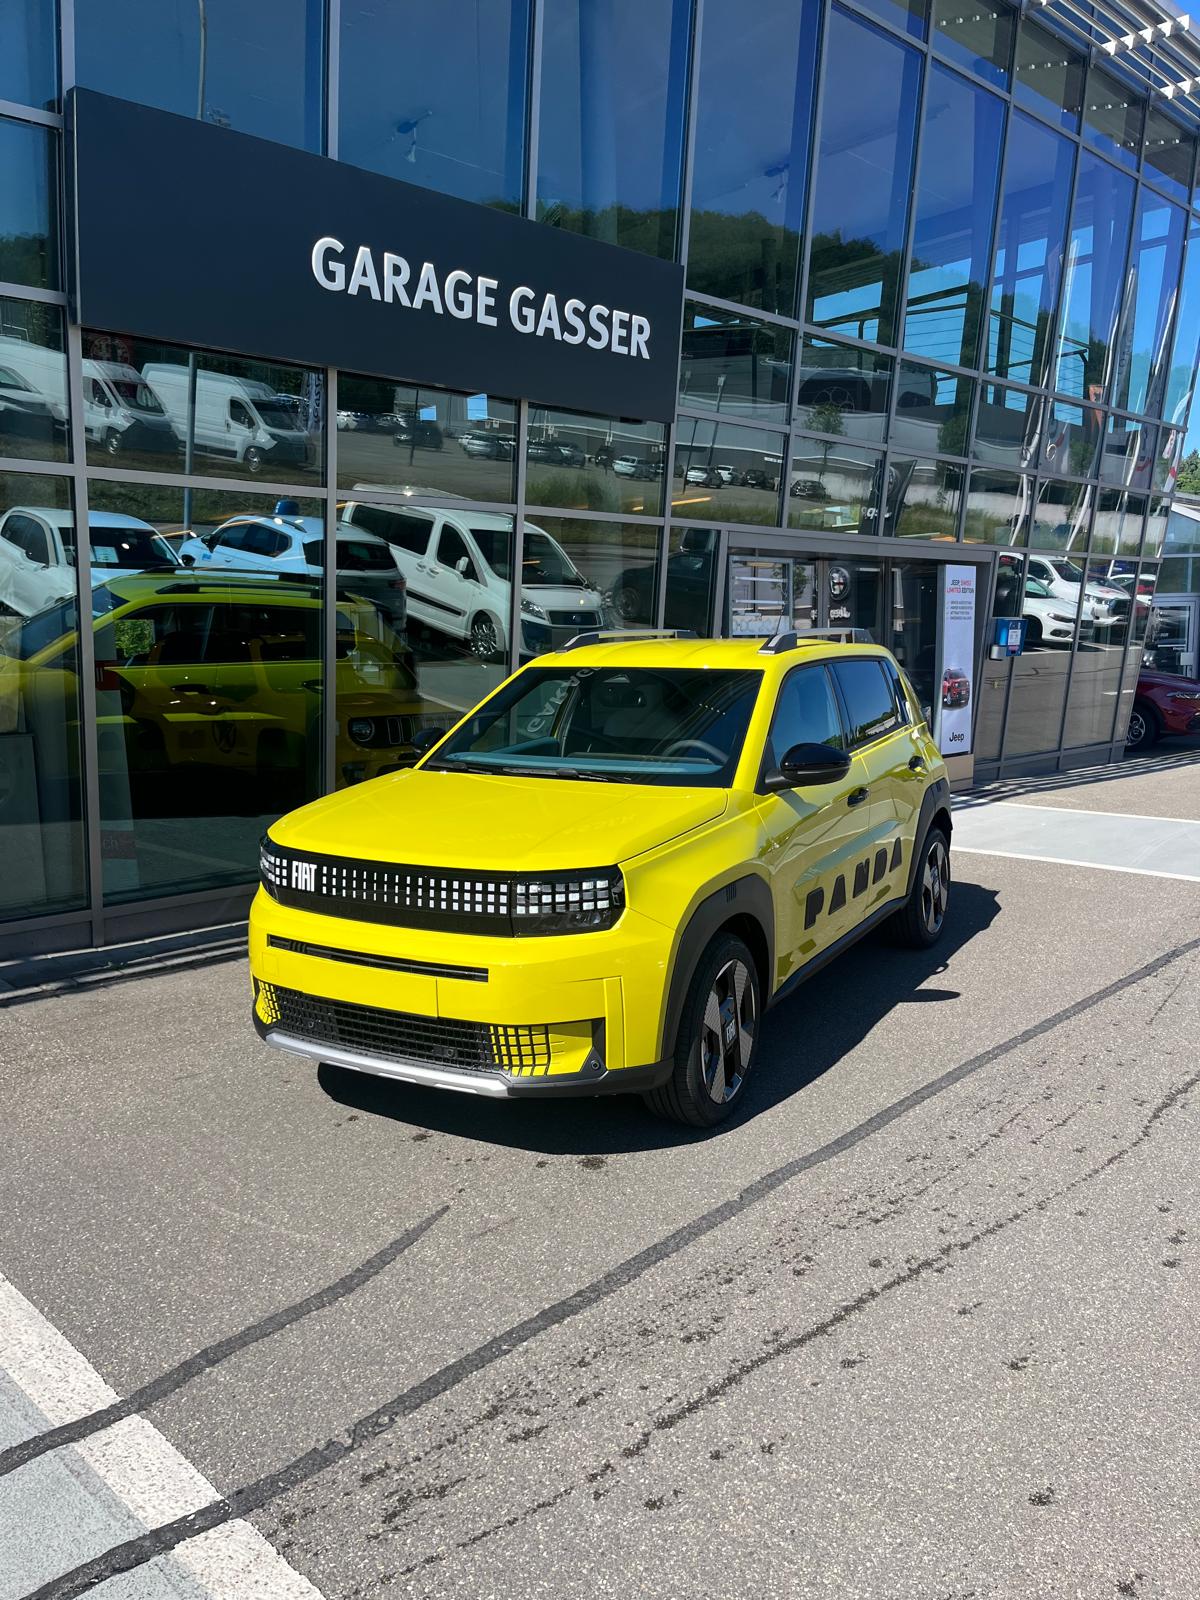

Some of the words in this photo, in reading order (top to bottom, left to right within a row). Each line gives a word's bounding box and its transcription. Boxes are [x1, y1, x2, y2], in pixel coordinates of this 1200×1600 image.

[311, 236, 499, 327] GARAGE
[509, 286, 651, 360] GASSER
[949, 731, 965, 744] Jeep
[291, 860, 318, 892] FIAT
[803, 836, 903, 931] PANDA
